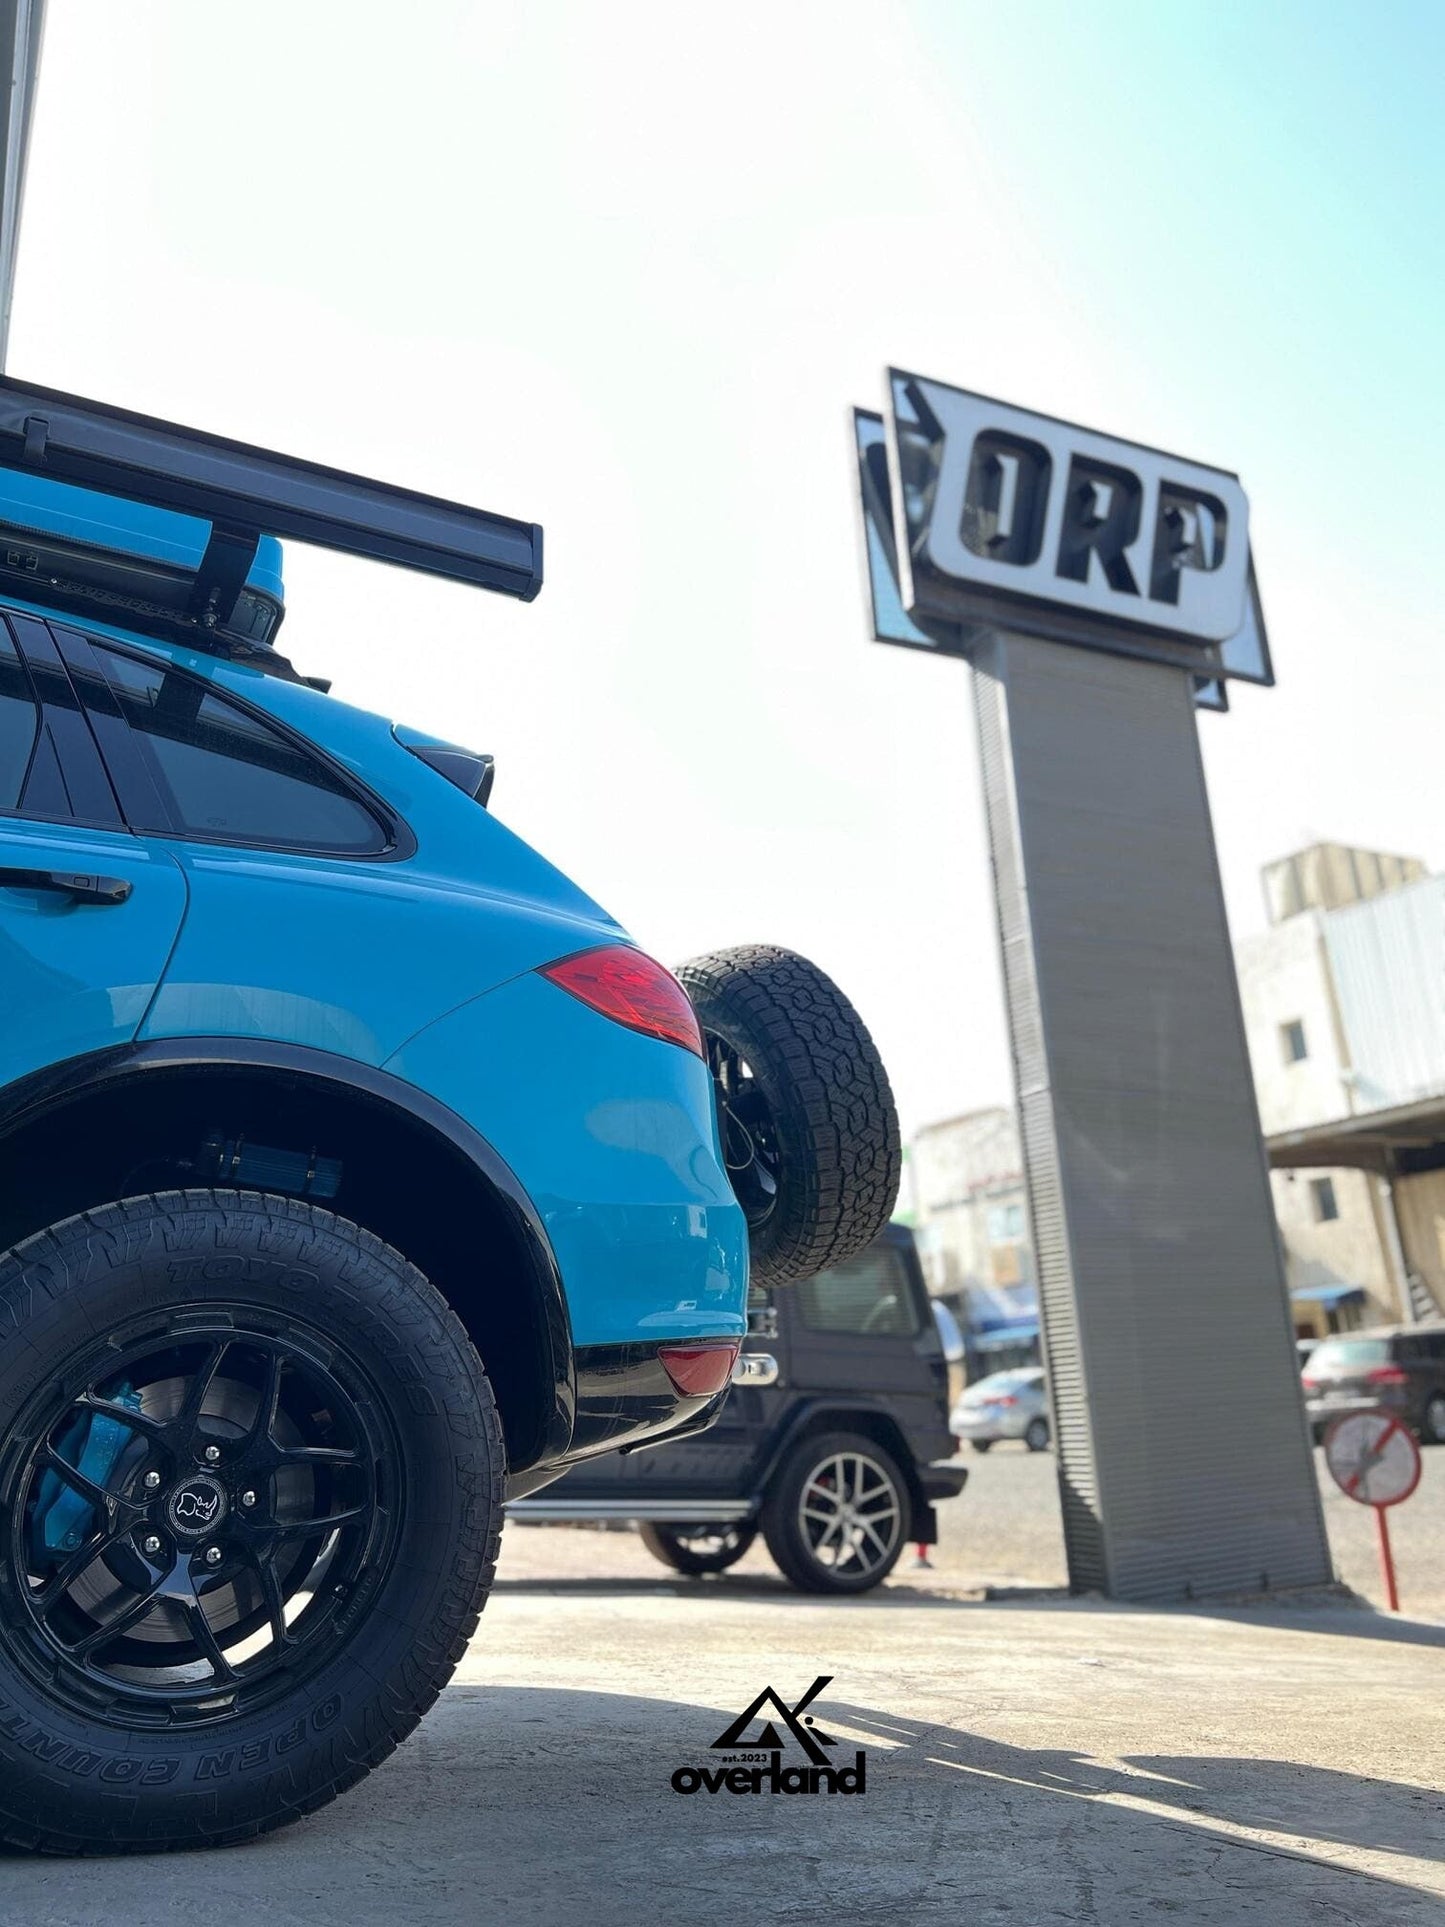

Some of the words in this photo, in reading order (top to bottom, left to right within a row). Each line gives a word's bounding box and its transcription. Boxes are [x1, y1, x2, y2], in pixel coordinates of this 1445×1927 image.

[958, 427, 1229, 607] ORP
[167, 1255, 321, 1290] TOYO
[0, 1703, 186, 1785] COUNT
[195, 1695, 344, 1781] OPEN
